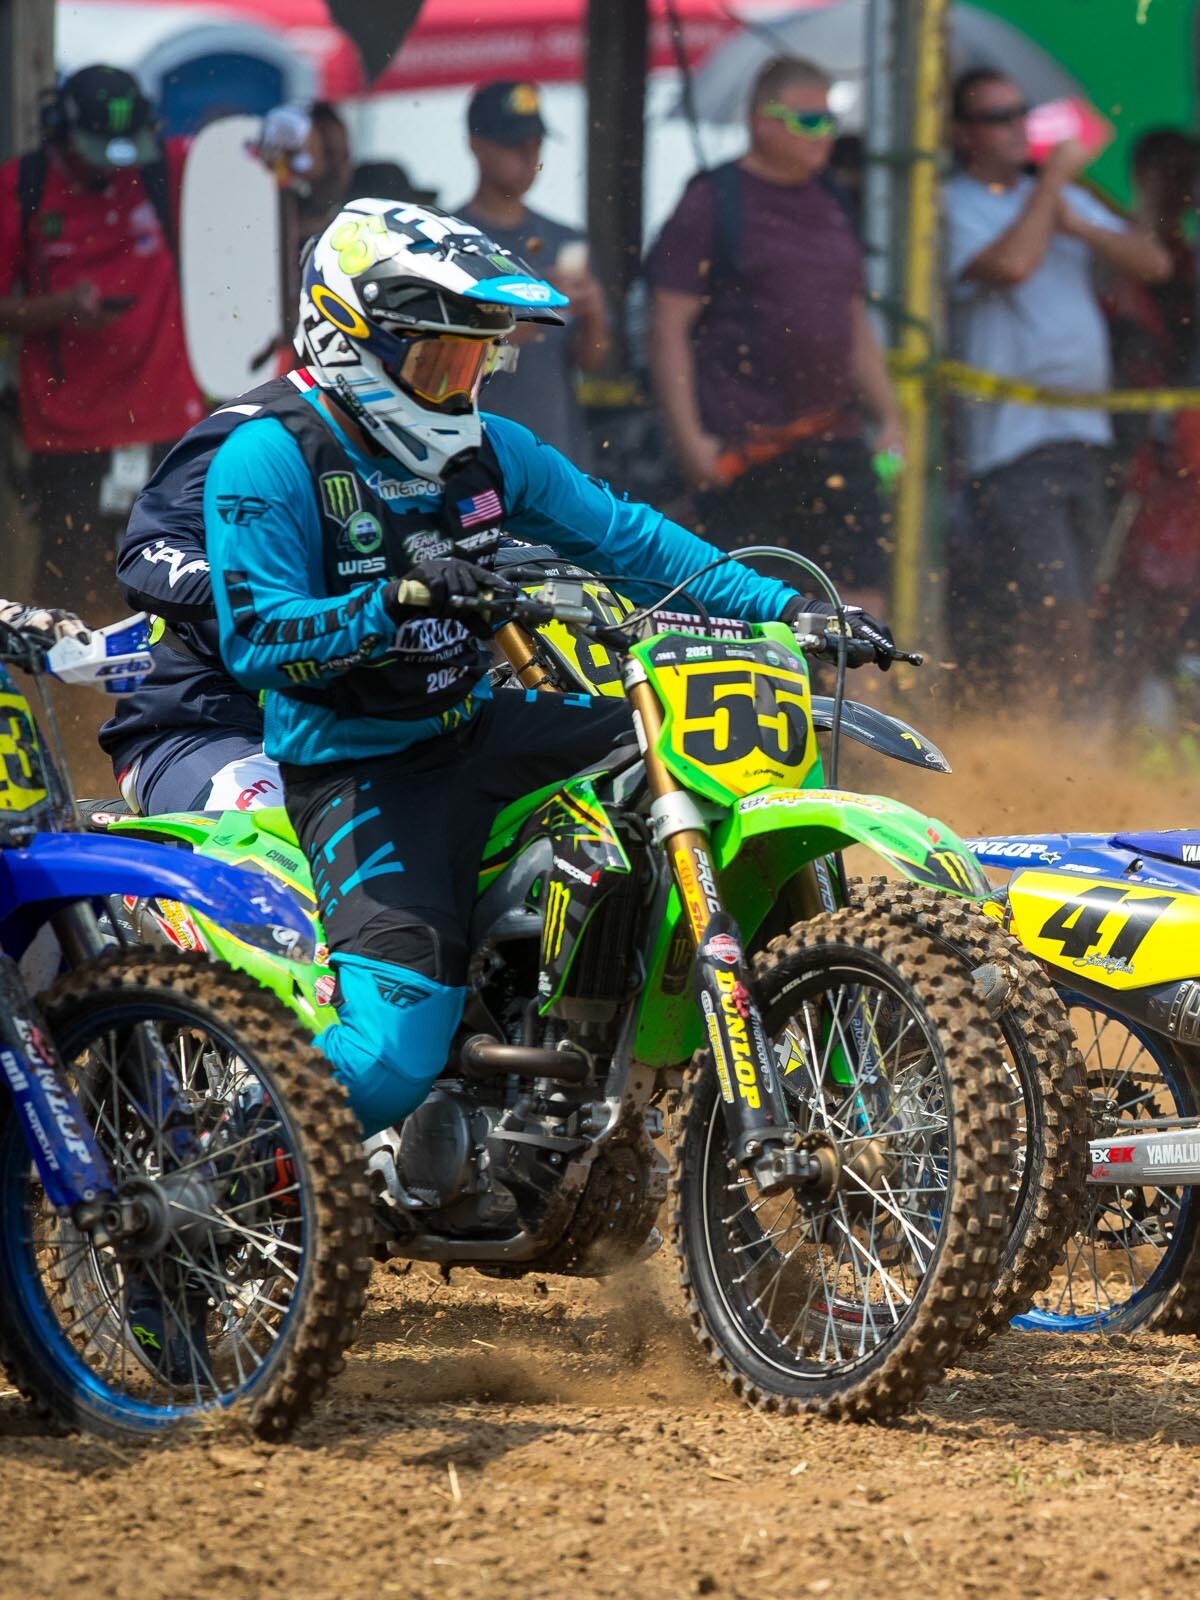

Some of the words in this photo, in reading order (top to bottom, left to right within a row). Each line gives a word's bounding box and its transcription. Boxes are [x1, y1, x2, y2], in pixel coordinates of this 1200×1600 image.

[404, 531, 439, 554] TEAM
[413, 540, 451, 564] GREEN
[338, 556, 387, 576] WPS
[685, 645, 713, 659] 2021
[683, 670, 809, 767] 55
[265, 849, 299, 873] CUNHA
[1038, 886, 1177, 966] 41
[715, 969, 761, 1110] DUNLOP
